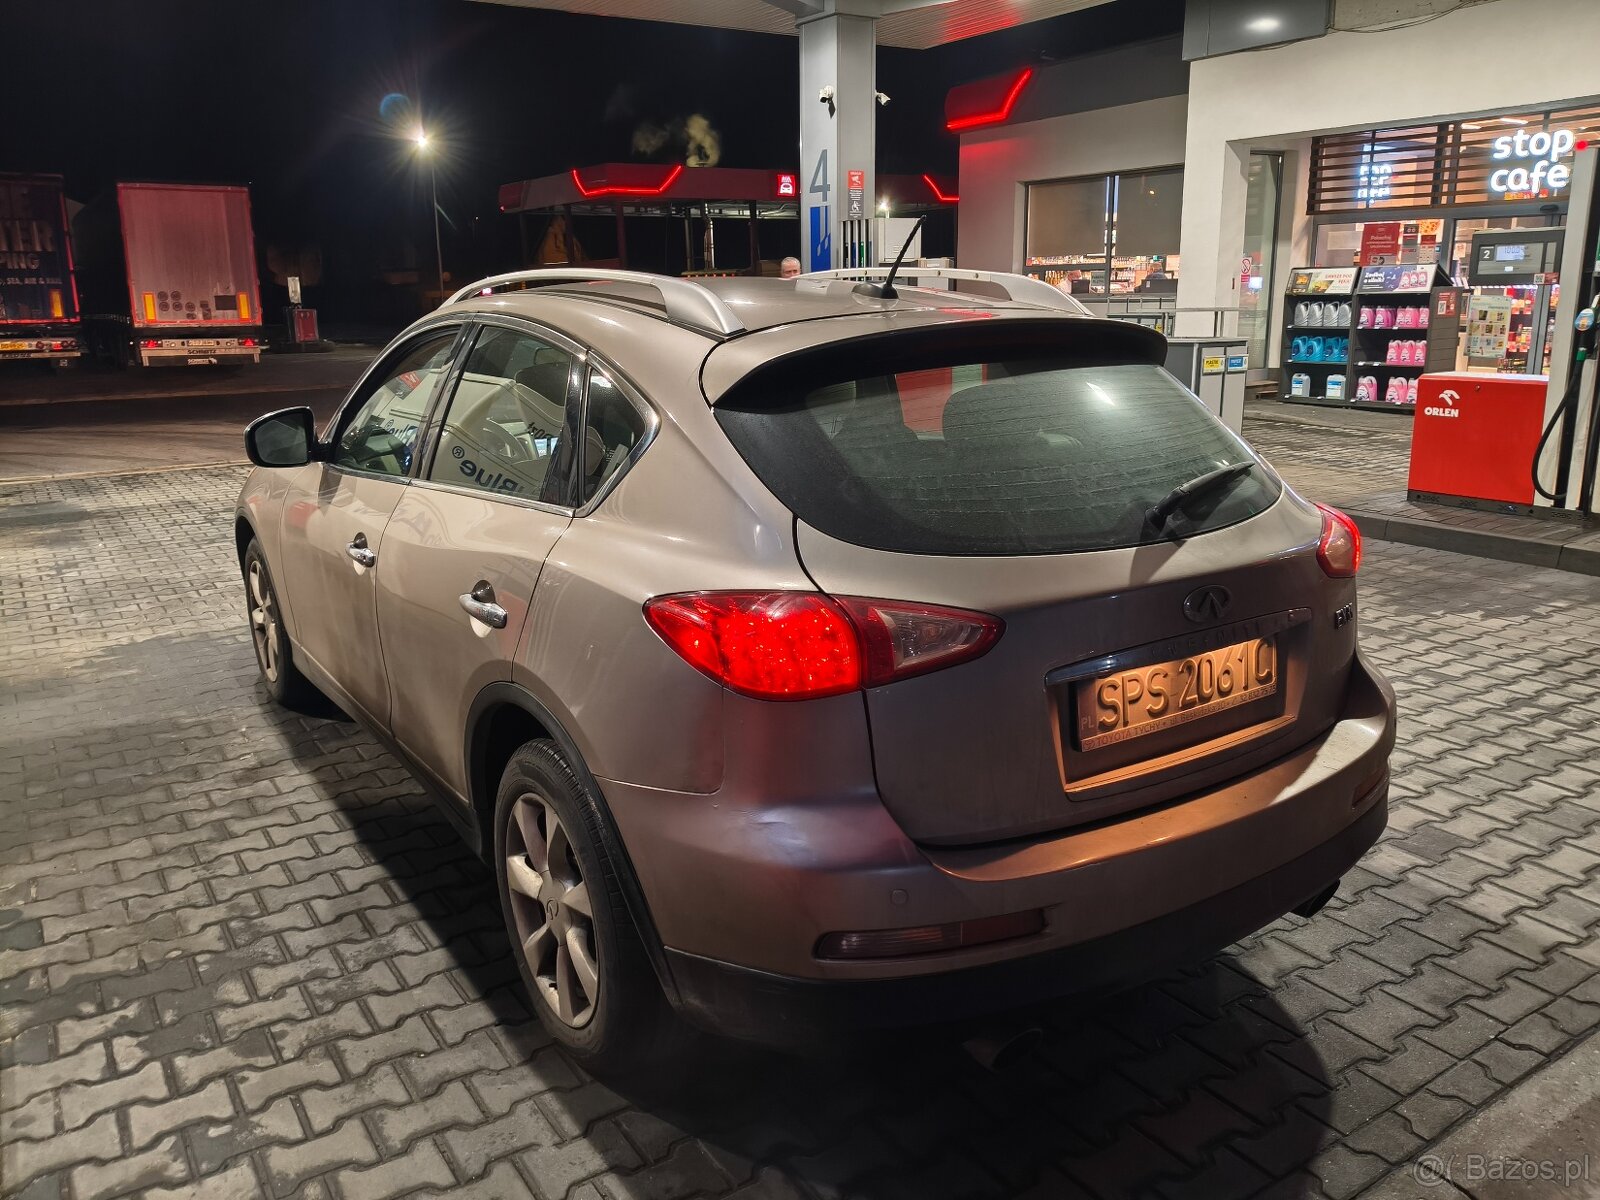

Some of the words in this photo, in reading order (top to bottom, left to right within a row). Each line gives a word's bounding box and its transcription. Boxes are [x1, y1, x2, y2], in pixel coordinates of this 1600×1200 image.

[1492, 129, 1574, 163] stop
[809, 148, 831, 202] 4
[1490, 159, 1570, 194] cafe
[1483, 250, 1491, 259] 2
[1424, 406, 1459, 418] ORLEN
[1097, 665, 1170, 730] SPS
[1177, 637, 1273, 709] 2061C
